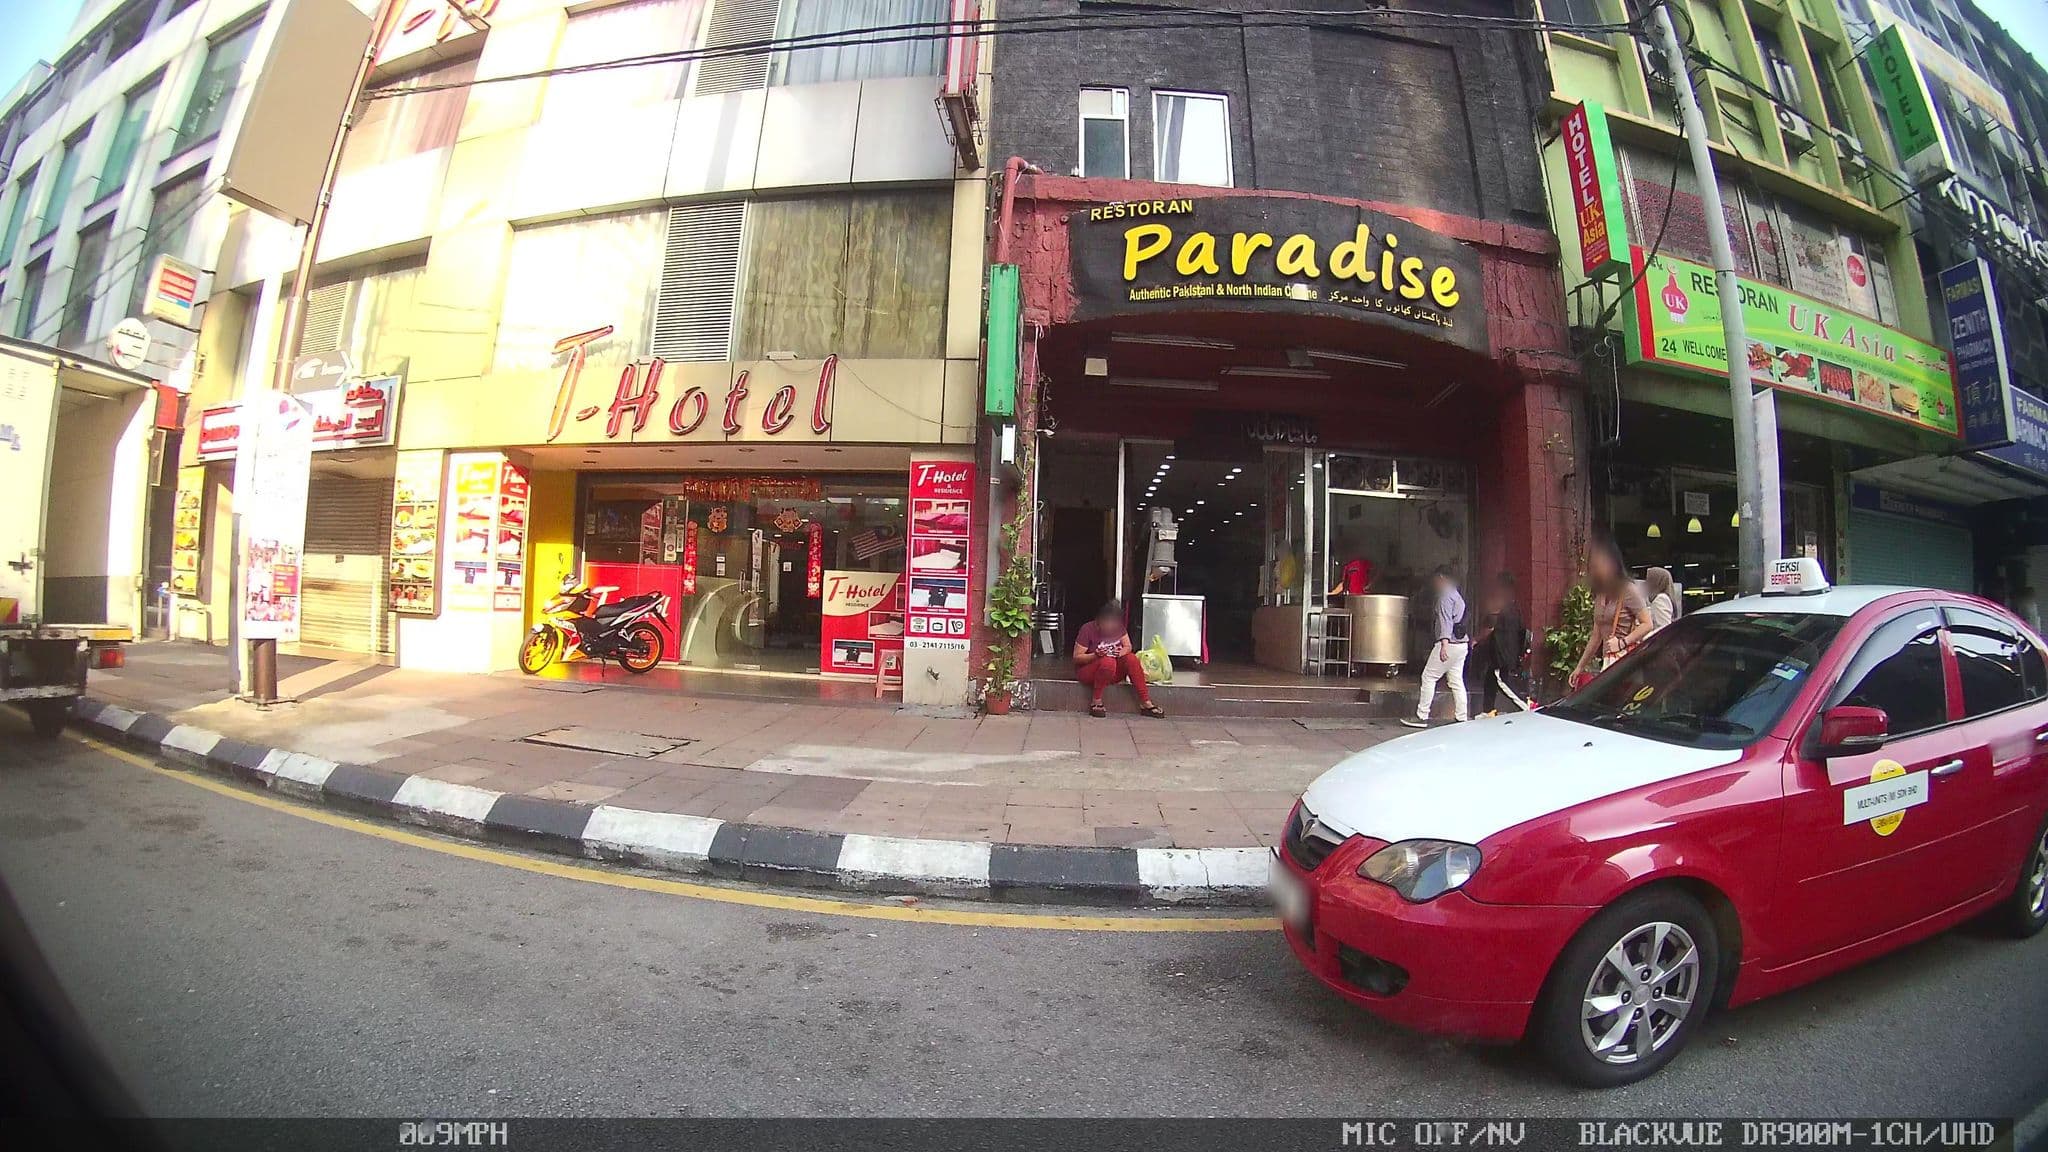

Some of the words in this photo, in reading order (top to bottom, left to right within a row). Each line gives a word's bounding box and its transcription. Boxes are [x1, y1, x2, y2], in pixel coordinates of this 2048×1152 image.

[1568, 113, 1595, 209] HOTEL
[1090, 199, 1193, 221] RESTORAN
[1579, 201, 1603, 229] UK
[1583, 219, 1605, 248] Asia
[1122, 222, 1460, 309] Paradise
[1129, 285, 1171, 301] Authentic
[1173, 283, 1214, 298] Pakistani
[1216, 283, 1223, 295] &
[1226, 283, 1251, 297] North
[1254, 283, 1282, 297] Indian
[1664, 293, 1686, 311] UK
[1690, 272, 1779, 314] REORAN
[1840, 325, 1896, 363] Asia
[1952, 307, 1988, 340] ZENITH
[1661, 337, 1677, 354] 24
[547, 324, 838, 442] T-Hotel
[917, 464, 968, 487] T-Hotel
[1771, 573, 1801, 585] BERMETER
[1775, 561, 1799, 573] TEKSI
[828, 576, 886, 602] T-Hotel
